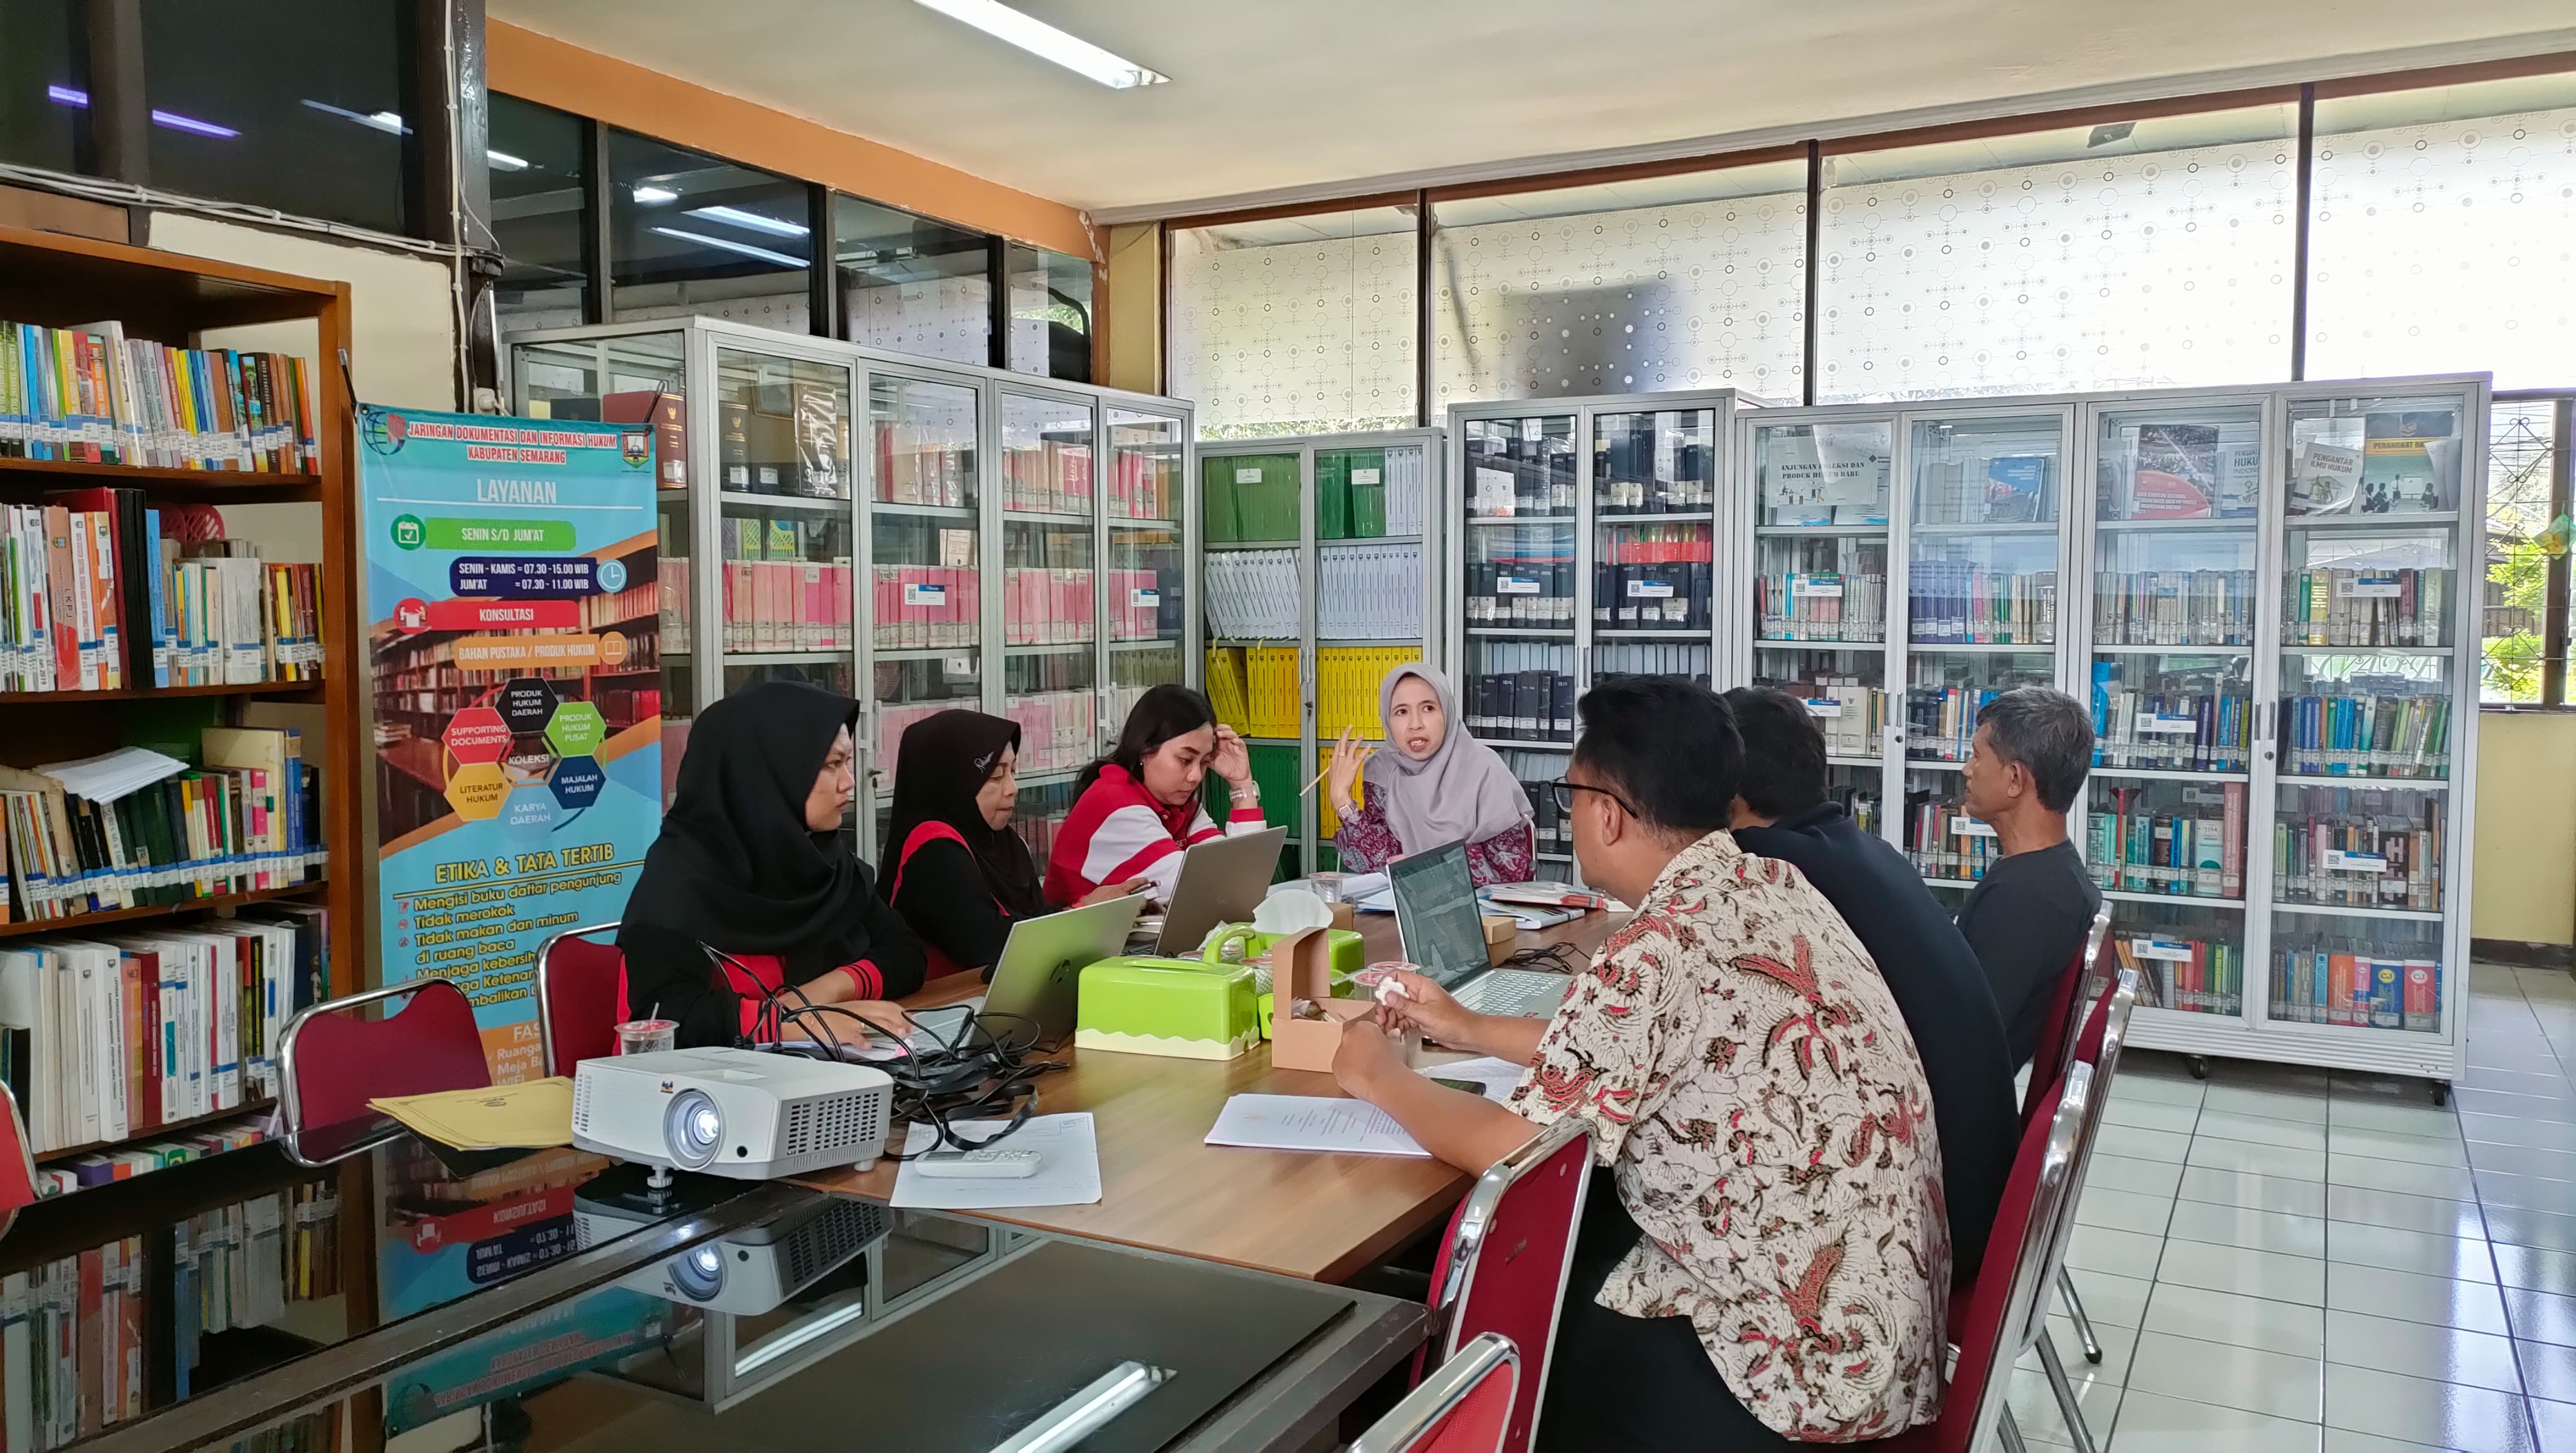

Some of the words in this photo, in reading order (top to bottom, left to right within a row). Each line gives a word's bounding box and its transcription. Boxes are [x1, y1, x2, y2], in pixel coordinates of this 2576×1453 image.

[409, 422, 454, 439] JARINGAN
[455, 425, 518, 443] DOKUMENTASI
[520, 430, 537, 445] DAN
[539, 431, 585, 447] INFORMASI
[587, 434, 617, 448] HUKUM
[2373, 441, 2413, 449] PERANGKAT
[468, 445, 518, 461] KABUPATEN
[520, 448, 567, 465] SEMARANG
[2313, 453, 2354, 466] PENGANTAR
[2234, 458, 2258, 467] HUKU
[2310, 460, 2326, 469] ILMU
[2327, 463, 2352, 474] HUKUM
[477, 479, 557, 504] LAYANAN
[461, 528, 489, 541] SENIN
[491, 528, 510, 541] S/D
[513, 530, 544, 542] JUM'AT
[459, 563, 484, 574] SENIN
[490, 564, 516, 574] KAMIS
[524, 564, 547, 574] 07.30
[574, 564, 589, 574] WIB
[459, 579, 487, 590] JUM'AT
[522, 579, 544, 589] 07.30
[552, 580, 573, 589] 11.00
[574, 580, 589, 589] WIB
[479, 608, 534, 621] KONSULTASI
[459, 648, 488, 660] BAHAN
[490, 647, 526, 660] PUSTAKA
[528, 645, 533, 658] /
[535, 645, 566, 657] PRODUK
[567, 644, 595, 657] HUKUM
[39, 669, 48, 686] 2019
[511, 689, 542, 699] PRODUK
[513, 699, 542, 707] HUKUM
[511, 708, 543, 717] DAERAH
[560, 713, 593, 722] PRODUK
[451, 724, 507, 736] SUPPORTING
[562, 723, 591, 732] HUKUM
[451, 735, 507, 746] DOCUMENTS
[565, 733, 588, 742] PUSAT
[508, 754, 550, 766] KOLEKSI
[561, 774, 598, 785] MAJALAH
[459, 783, 503, 794] LITERATUR
[565, 784, 594, 794] HUKUM
[466, 793, 498, 803] HUKUM
[514, 803, 546, 813] KARYA
[510, 813, 550, 825] DAERAH
[435, 859, 490, 883] ETIKA
[494, 857, 510, 876] &
[516, 851, 557, 874] TATA
[561, 843, 615, 868] TERTIB
[414, 891, 468, 912] Mengisi
[471, 887, 505, 904] buku
[508, 883, 547, 899] daftar
[550, 871, 622, 894] pengunjung
[415, 910, 453, 930] Tidak
[455, 904, 515, 925] merokok
[415, 930, 453, 948] Tidak
[455, 923, 503, 942] makan
[507, 918, 533, 933] dan
[536, 910, 579, 928] minum
[416, 949, 430, 965] di
[433, 942, 474, 961] ruang
[477, 940, 515, 956] baca
[416, 962, 479, 980] Menjaga
[482, 952, 536, 971] kebersih
[482, 970, 534, 987] Ketena
[469, 987, 528, 1008] mbalikan
[513, 1023, 541, 1041] FAS
[497, 1043, 542, 1060] Ruanga
[497, 1062, 527, 1076] Meja
